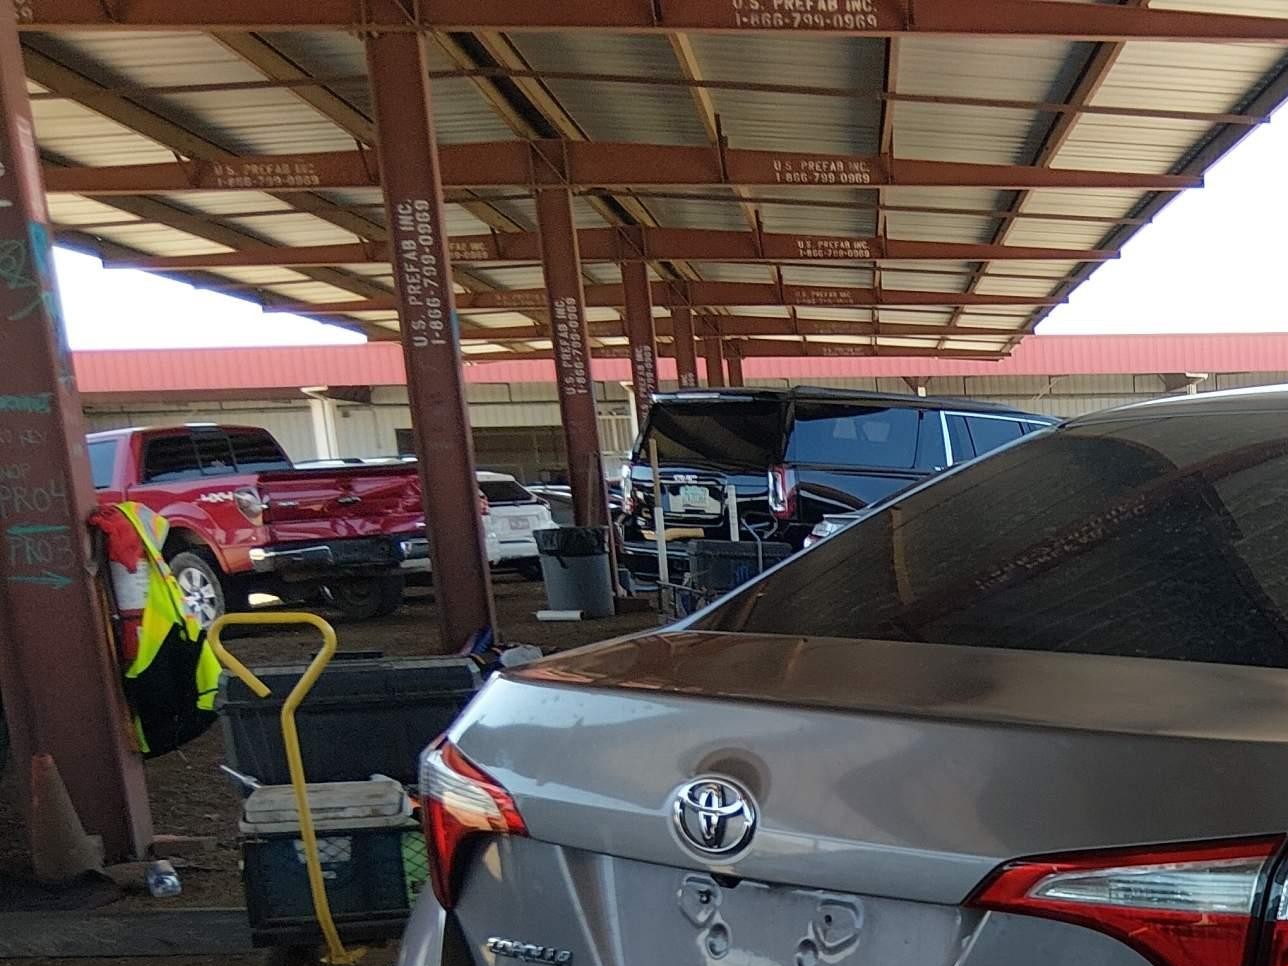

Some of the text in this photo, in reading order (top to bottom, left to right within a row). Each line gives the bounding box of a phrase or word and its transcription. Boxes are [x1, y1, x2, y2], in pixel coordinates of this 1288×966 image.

[774, 0, 838, 11] PREFAB
[846, 0, 878, 12] INC.
[397, 198, 416, 232] INC.
[401, 239, 424, 306] PREFAB
[413, 199, 447, 346] 1-866-799-0969
